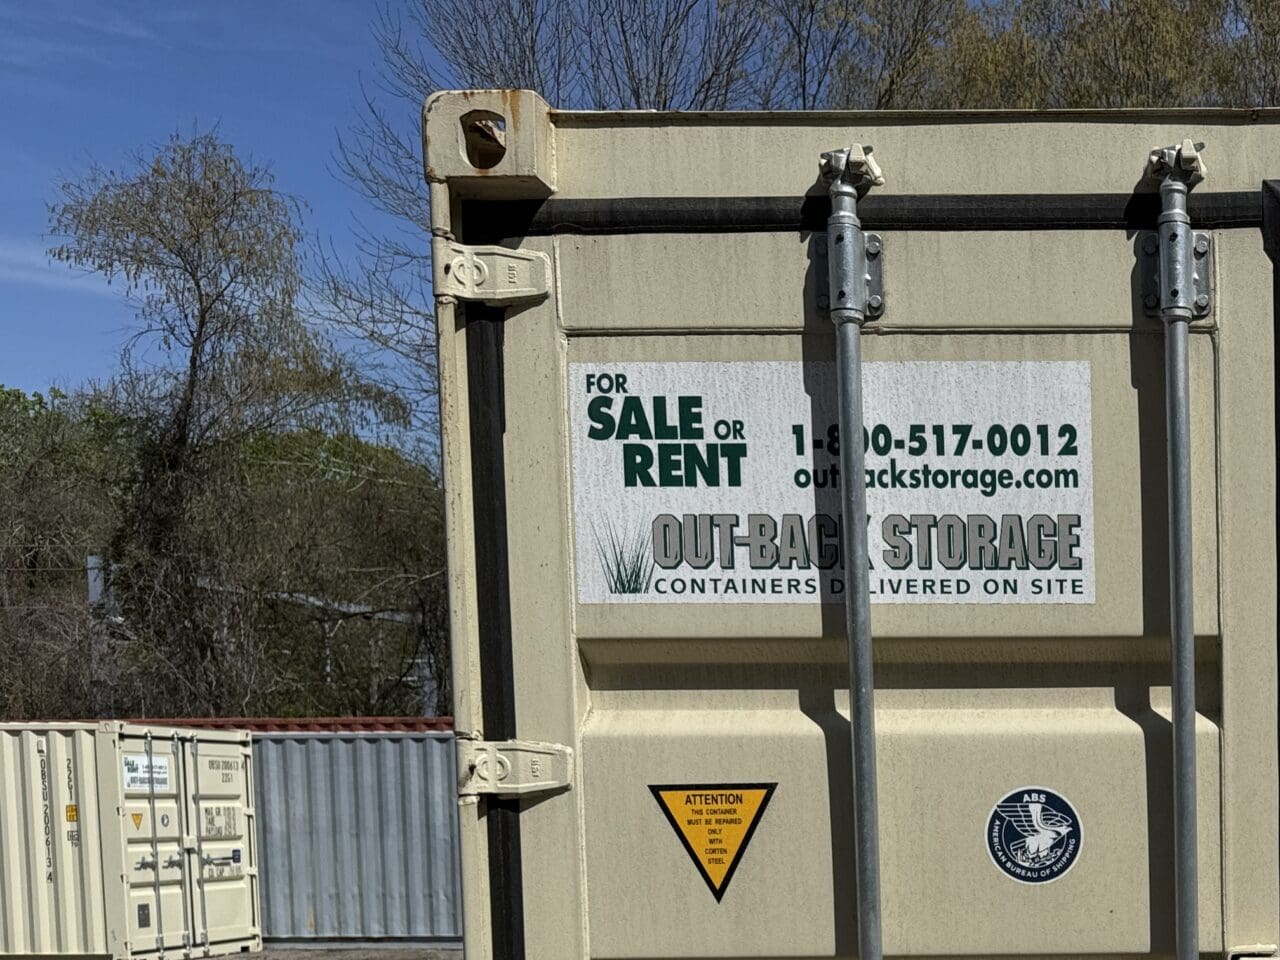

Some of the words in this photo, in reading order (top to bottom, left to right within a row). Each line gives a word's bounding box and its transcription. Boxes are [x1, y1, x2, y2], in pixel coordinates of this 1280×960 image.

[586, 373, 628, 394] FOR
[587, 395, 704, 441] SALE
[714, 419, 746, 440] OR
[792, 423, 1079, 457] 1-80-517-0012
[623, 443, 748, 488] RENT
[794, 458, 1080, 497] outackstorage.com
[881, 513, 1083, 571] STORAGE
[654, 577, 817, 595] CONTAINERS
[830, 577, 971, 595] DIVERED
[983, 578, 1018, 595] ON
[1030, 578, 1084, 595] SITE
[685, 793, 743, 805] ATTENTION
[1022, 793, 1046, 803] ABS
[992, 819, 1007, 863] AMERICAN
[1005, 862, 1038, 878] BUREAU
[1040, 869, 1051, 877] OF
[1052, 838, 1076, 872] SHIPPING
